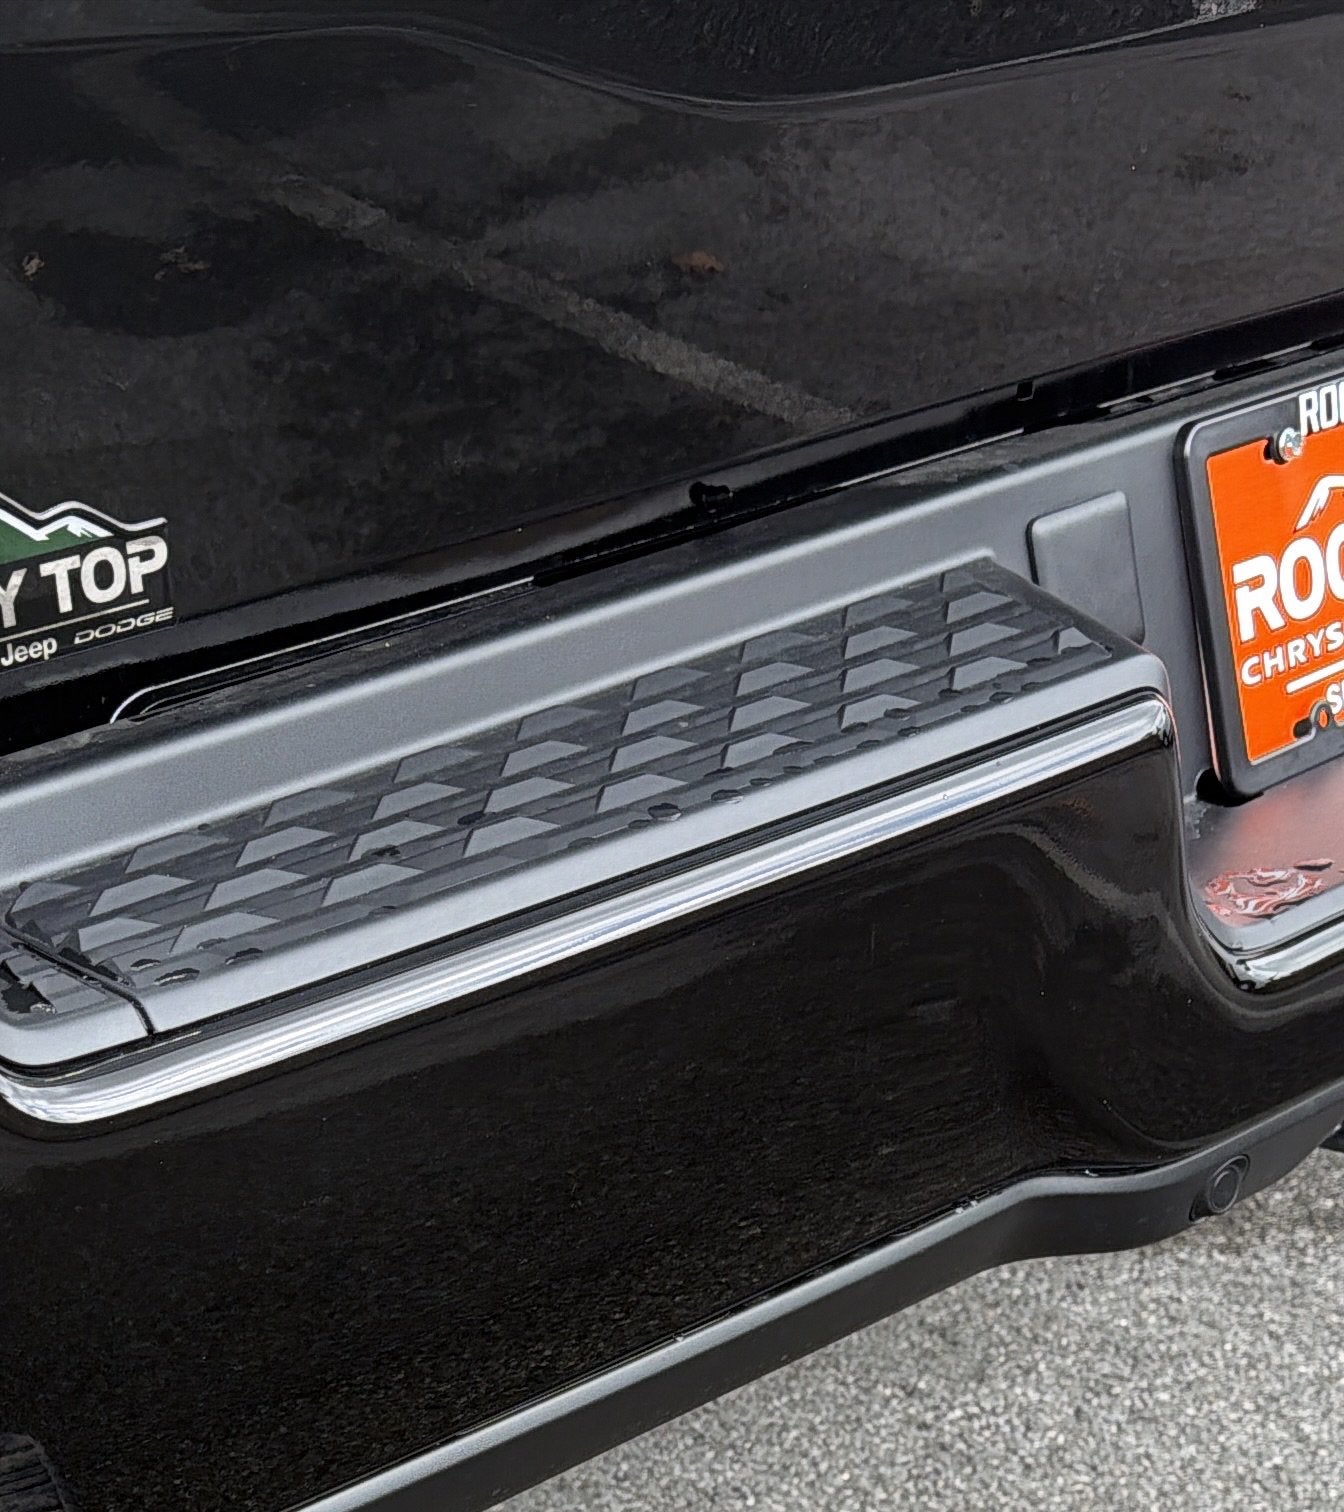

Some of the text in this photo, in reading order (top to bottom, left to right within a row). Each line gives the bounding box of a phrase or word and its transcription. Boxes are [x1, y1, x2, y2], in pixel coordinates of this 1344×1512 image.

[39, 535, 168, 614] TOP
[0, 636, 58, 667] Jeep
[73, 606, 174, 645] DODGE
